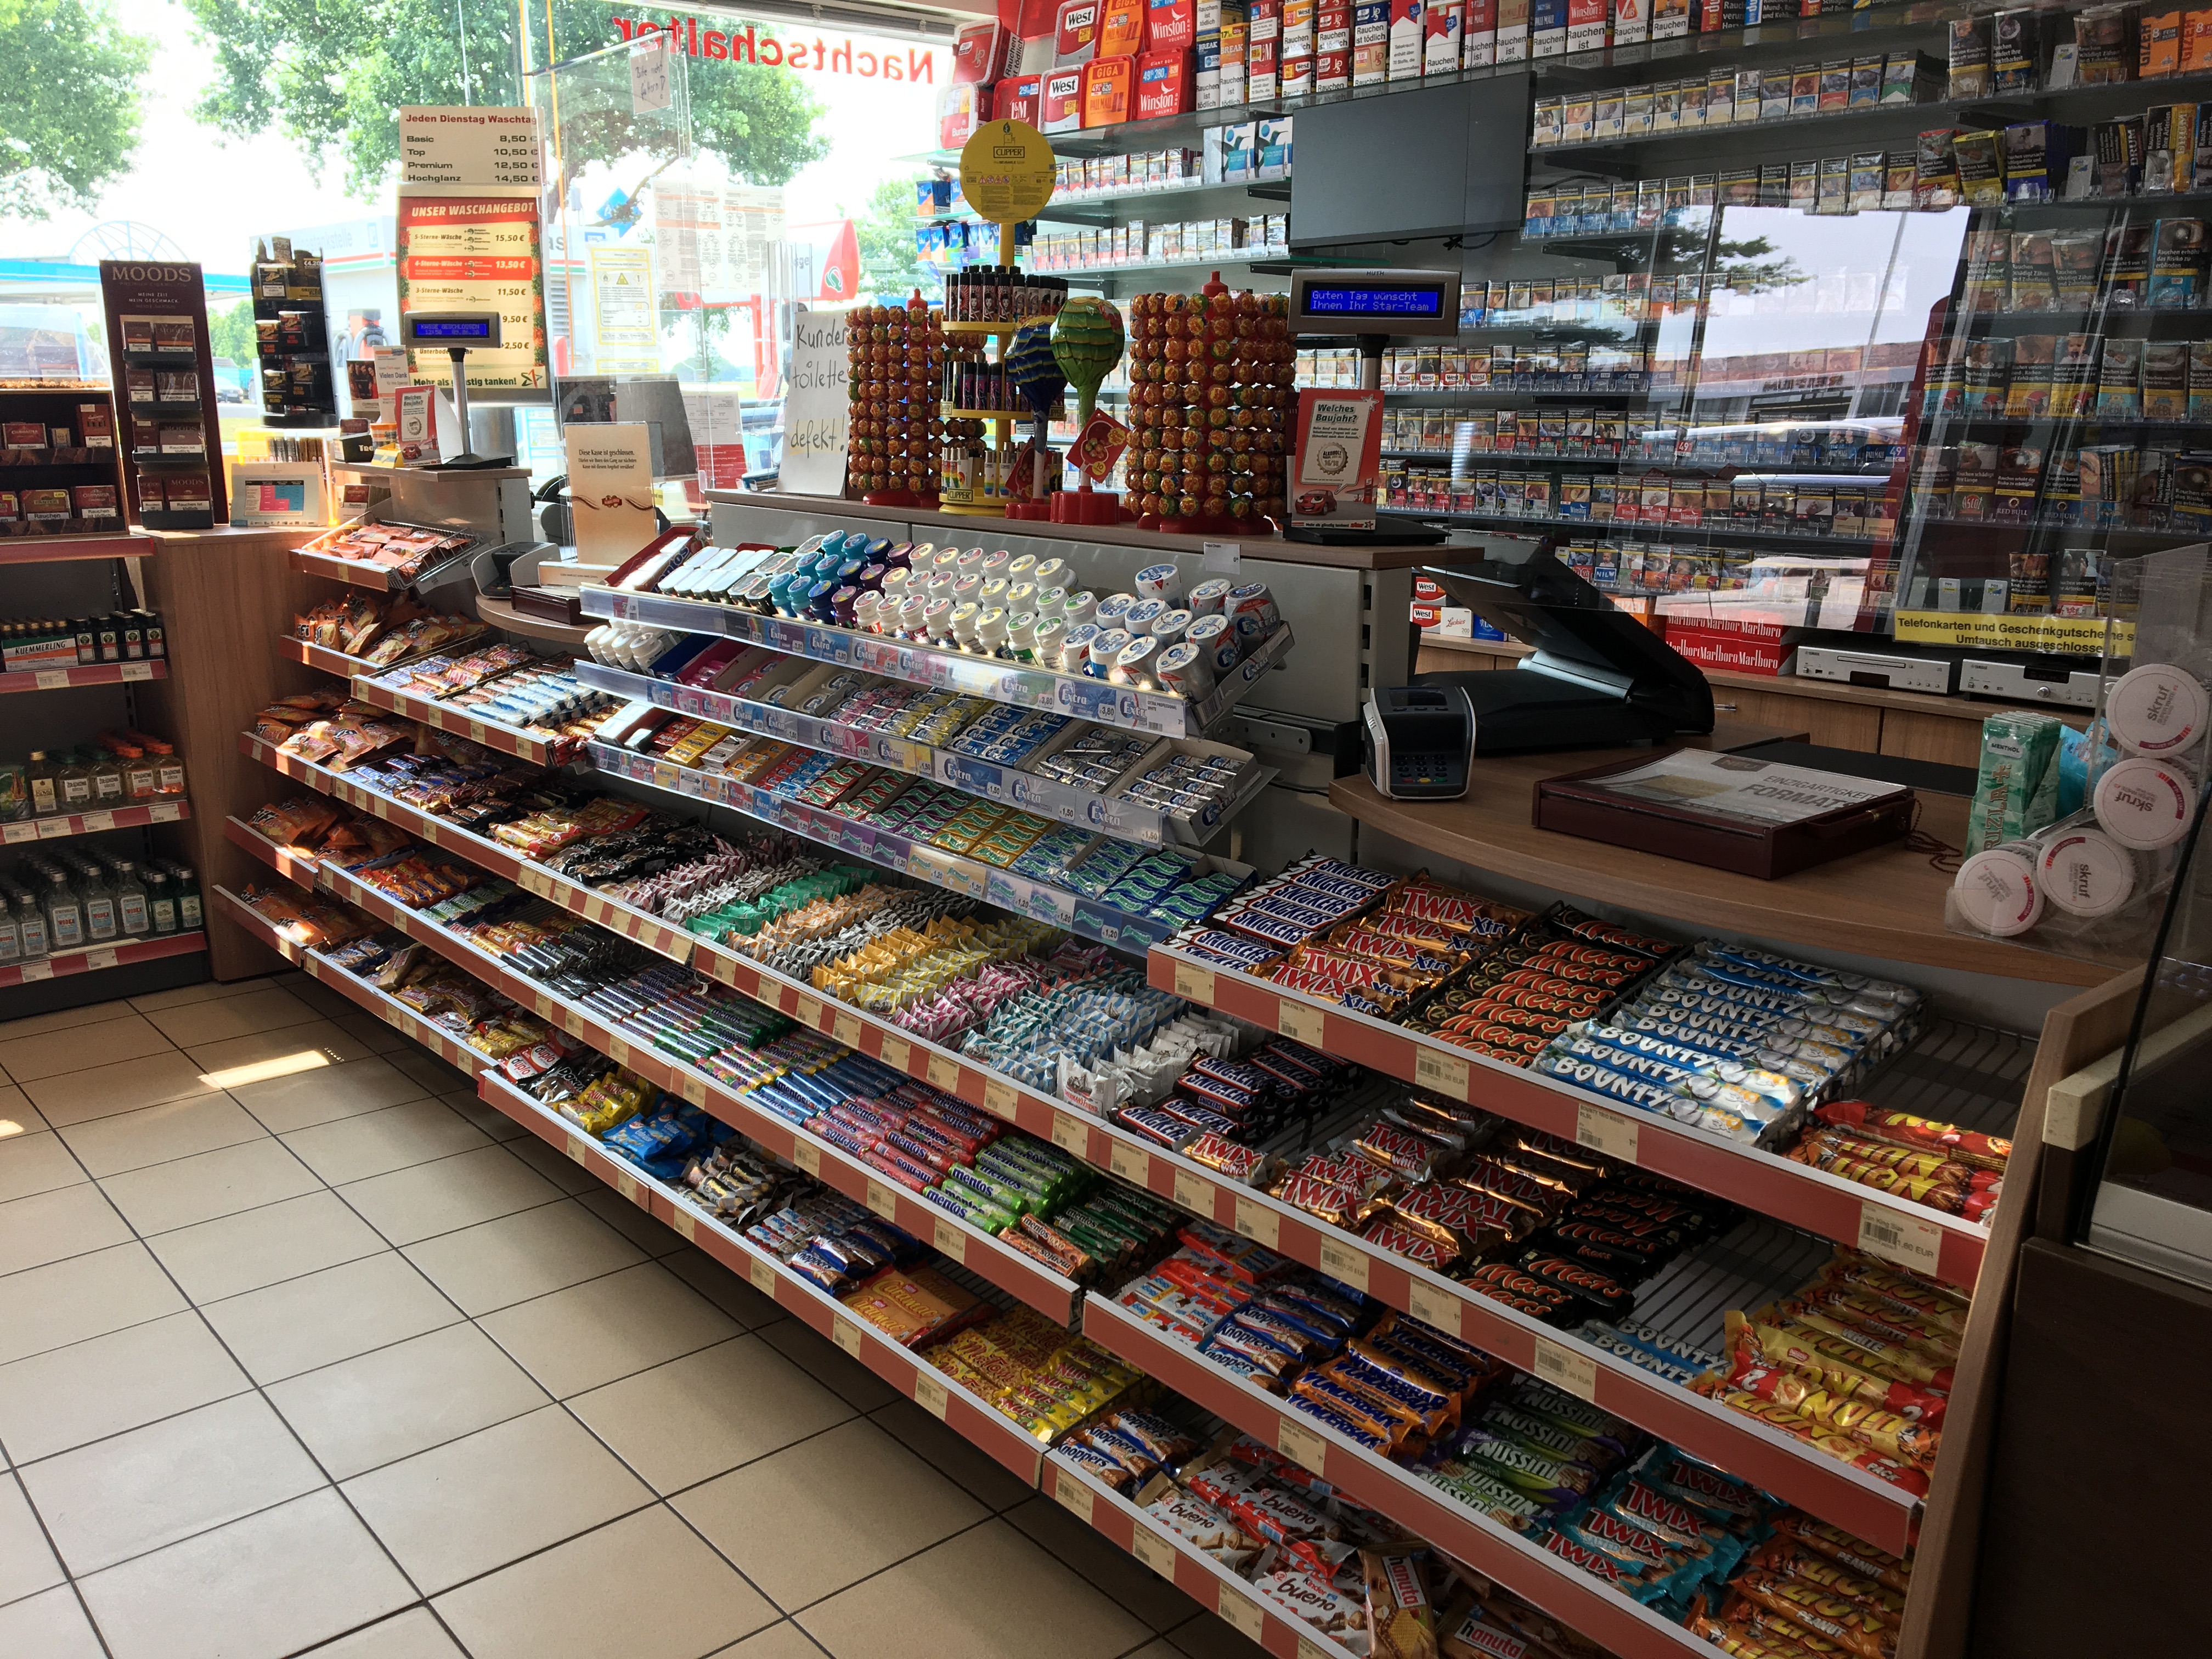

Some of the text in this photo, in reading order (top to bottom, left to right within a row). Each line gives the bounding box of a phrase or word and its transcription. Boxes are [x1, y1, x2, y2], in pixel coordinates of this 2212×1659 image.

[1068, 10, 1092, 25] West
[1151, 18, 1186, 39] Winston
[1199, 41, 1217, 49] BREAK
[1221, 44, 1243, 54] BREAK
[1364, 33, 1385, 42] tödlich
[2138, 23, 2151, 67] GIZEH
[1015, 38, 1024, 70] tödlich
[1097, 65, 1118, 78] GIGA
[1052, 79, 1075, 93] West
[1141, 94, 1172, 111] Winston
[440, 115, 485, 125] Dienstag
[488, 115, 537, 125] Waschtag
[2177, 113, 2187, 155] DRUM
[2128, 129, 2137, 166] DRUM
[412, 202, 534, 217] UNSER WASCHANGEBOT
[112, 266, 191, 282] MOODS
[1312, 291, 1418, 301] Guten Tag wünscht
[1313, 301, 1429, 311] Ihnen Ihr Star-Team
[793, 359, 847, 388] toilette
[1316, 414, 1357, 424] Baujahr?
[1318, 404, 1354, 413] Welches
[609, 449, 635, 457] geschlossen.
[949, 491, 969, 499] CLIPPER
[1997, 509, 2011, 517] RED
[1447, 617, 1465, 627] Luckies
[1741, 618, 1781, 638] Marlboro
[1898, 618, 1971, 631] Telefonkarten
[1974, 623, 1995, 633] und
[15, 641, 65, 656] KUEMMERLING
[1956, 635, 2011, 648] Umtausch
[1701, 644, 1738, 664] Marlboro
[2147, 685, 2170, 721] skruf
[1991, 743, 2020, 754] MENTHOL
[2113, 791, 2154, 812] skruf
[1300, 855, 1393, 887] 2 SNICKERS
[1295, 871, 1373, 901] SNICKERS
[1255, 880, 1358, 916] 2 SNICKERS
[1403, 885, 1487, 927] TWIX
[1251, 896, 1335, 927] SNICKERS
[1573, 921, 1673, 953] Mars
[1304, 947, 1384, 986] TWIX
[1539, 940, 1655, 972] Mars
[1272, 962, 1355, 997] TWIX
[1502, 969, 1616, 1003] Mars
[1688, 977, 1807, 1013] BOUNTY
[1661, 988, 1780, 1026] BOUNTY
[1637, 1018, 1757, 1057] BOUNTY
[511, 1057, 530, 1076] duplo
[534, 1046, 555, 1064] duplo
[844, 1100, 882, 1126] mentos
[888, 1131, 926, 1158] mentos
[951, 1165, 994, 1197] mentos
[1831, 1157, 1943, 1201] LION
[1023, 1216, 1049, 1239] mentos
[1915, 1246, 1934, 1257] EUR
[875, 1279, 937, 1318] Caramac
[1218, 1322, 1273, 1351] Knoppers
[1843, 1328, 1886, 1352] WHITE
[1057, 1362, 1092, 1382] Nuts
[1866, 1462, 1903, 1482] PACK
[1169, 1496, 1215, 1529] bueno
[1836, 1551, 1884, 1578] PEANUT
[1388, 1555, 1420, 1606] hanuta
[1277, 1578, 1336, 1611] bueno
[1795, 1610, 1846, 1638] PEANUT
[1461, 1621, 1522, 1658] hanuta
